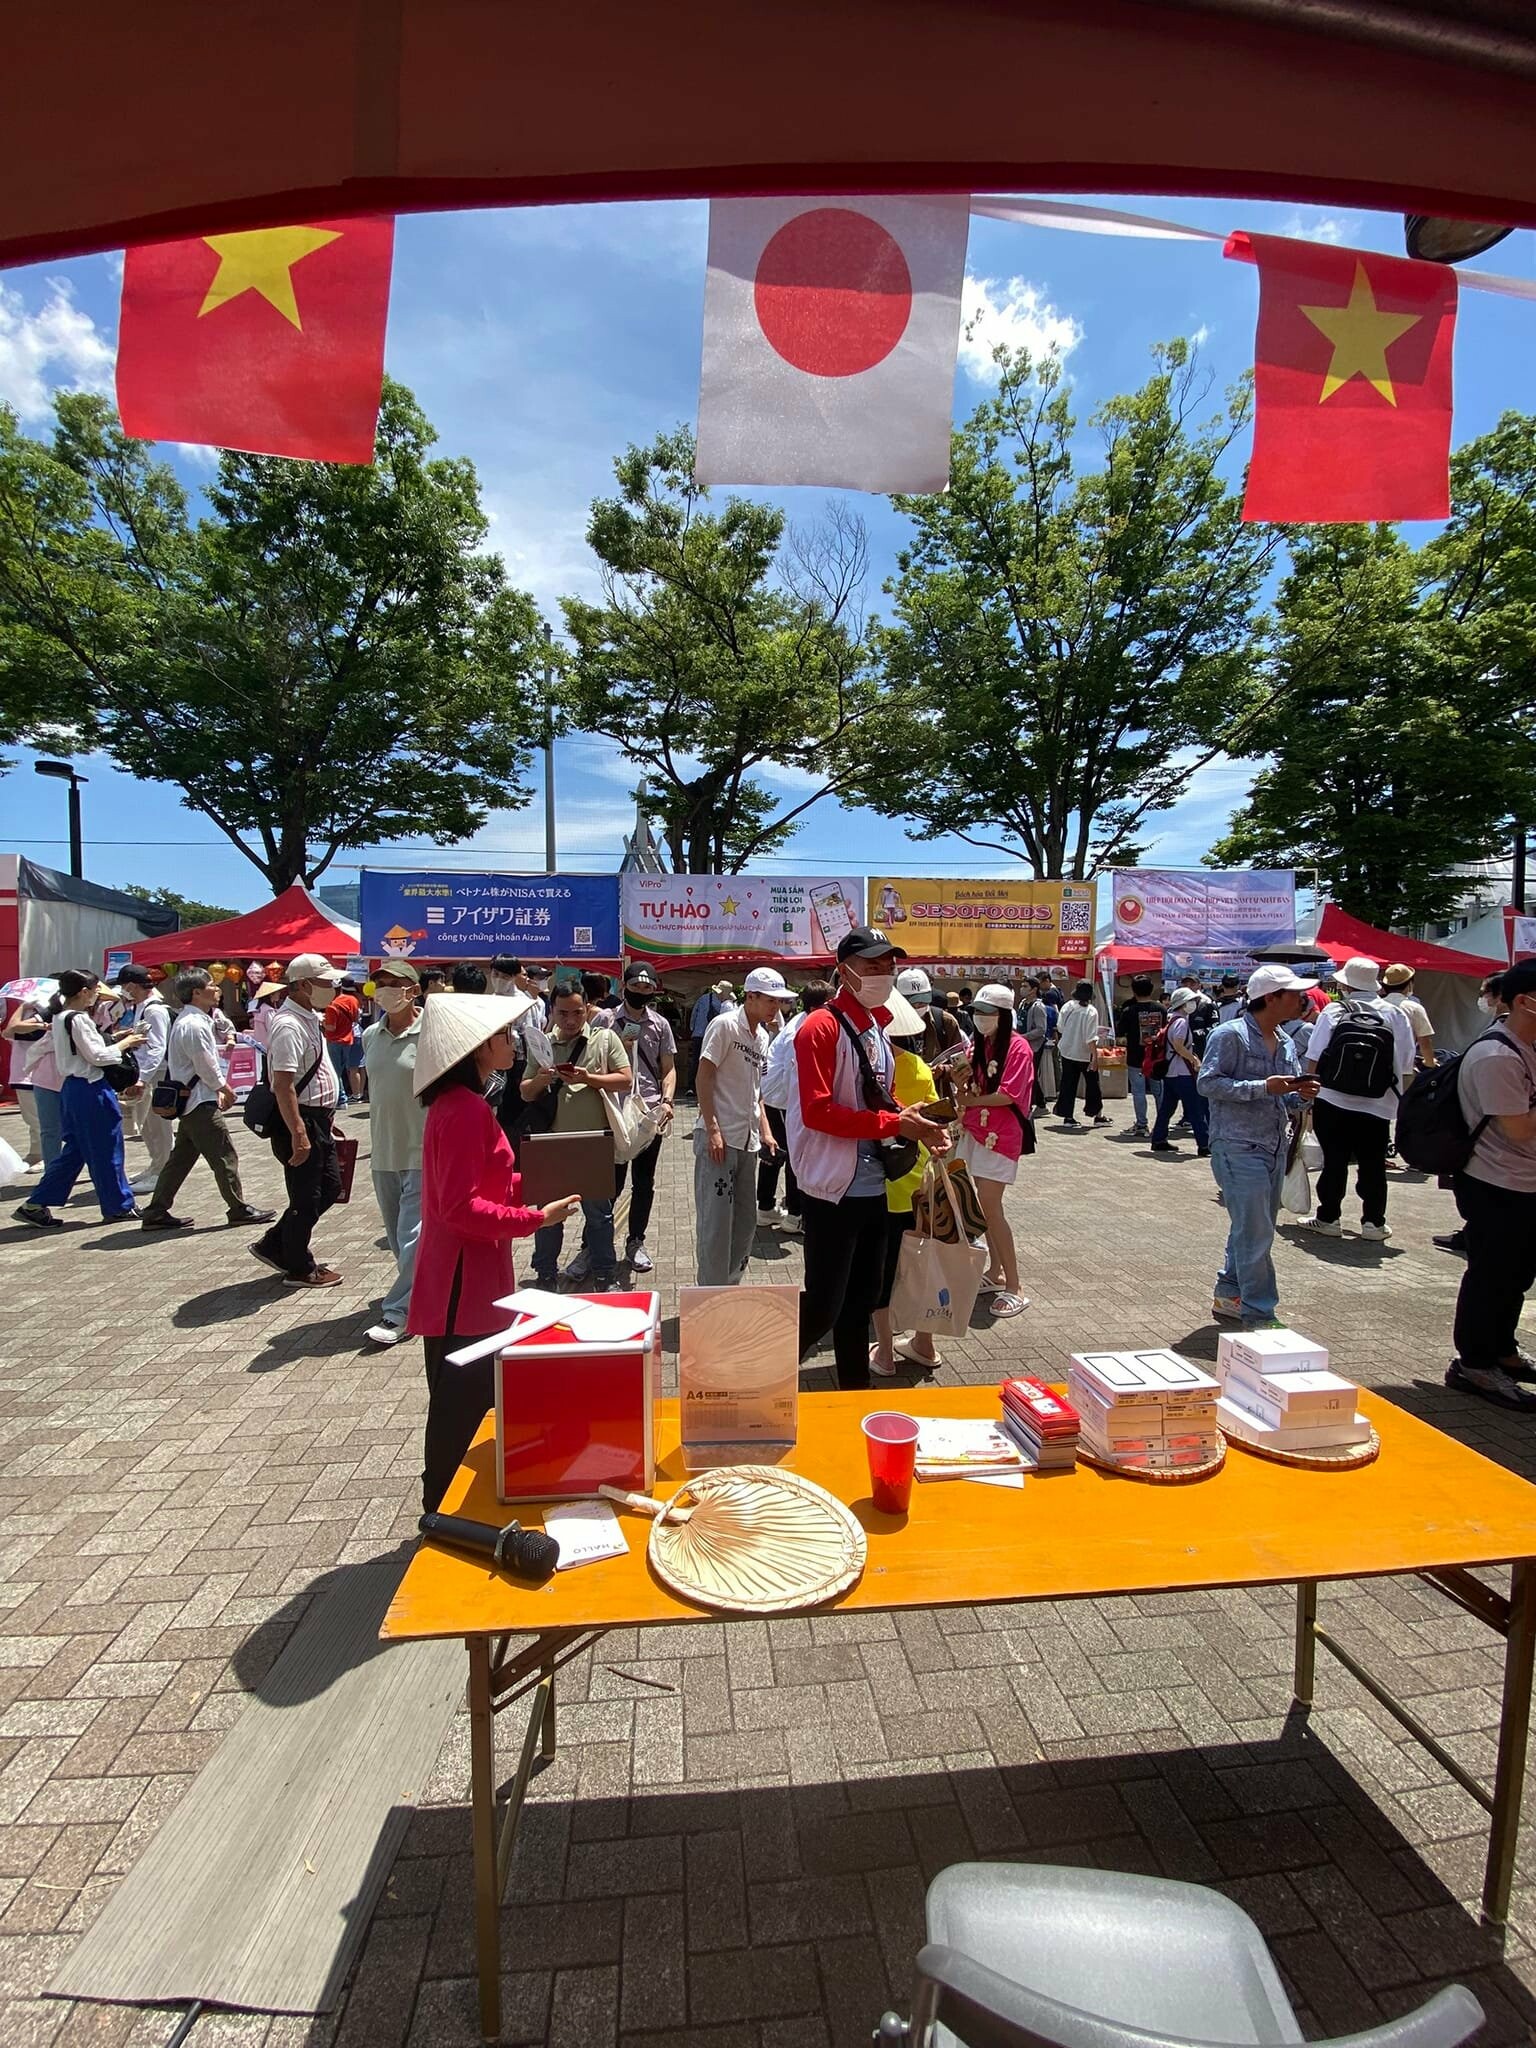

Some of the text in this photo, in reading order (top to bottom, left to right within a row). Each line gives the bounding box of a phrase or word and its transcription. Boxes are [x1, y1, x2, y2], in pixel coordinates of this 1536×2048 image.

[639, 880, 662, 888] ViPro
[770, 886, 787, 894] MUA
[670, 899, 711, 919] HÀO
[911, 902, 1052, 920] SESOFOODS
[451, 907, 551, 926] アイザワ証券
[438, 932, 458, 943] công
[459, 934, 467, 943] ty
[495, 931, 520, 941] khoán
[522, 933, 550, 941] Aizawa
[686, 1390, 704, 1401] A4
